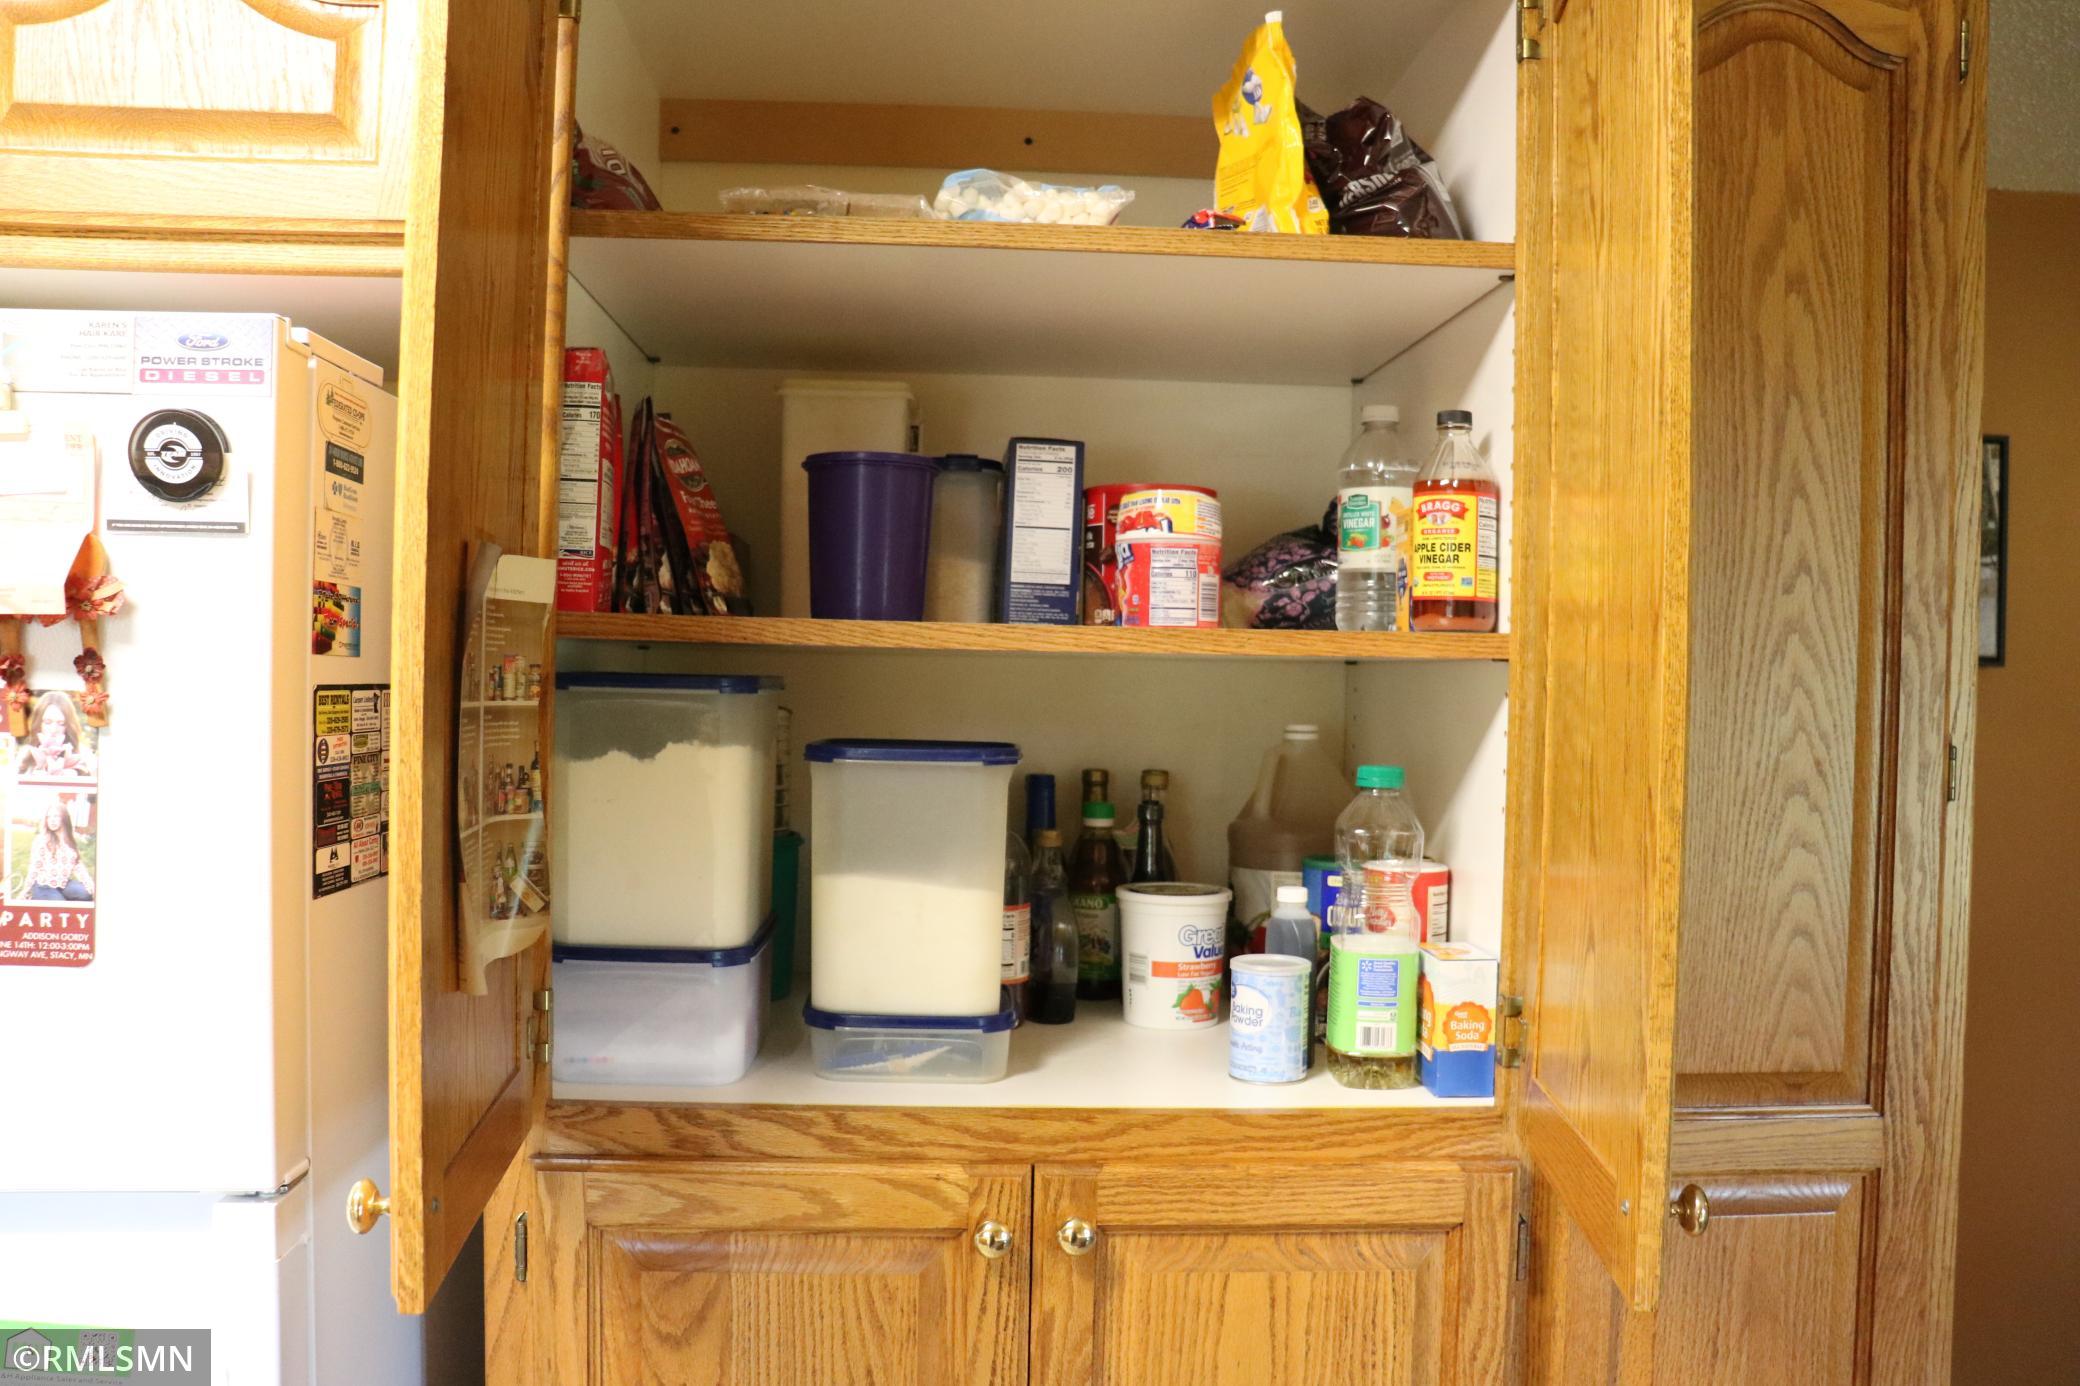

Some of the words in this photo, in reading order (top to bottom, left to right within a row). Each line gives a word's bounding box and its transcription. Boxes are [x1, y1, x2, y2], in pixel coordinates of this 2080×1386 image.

[184, 334, 221, 349] Ford
[140, 356, 197, 365] POWER
[200, 357, 264, 366] STROKE
[144, 369, 261, 383] DIESEL
[589, 411, 601, 419] 170
[1057, 465, 1073, 473] 200
[1421, 500, 1461, 512] BRAGG
[1343, 517, 1375, 529] VINEGAR
[1414, 543, 1436, 553] APPLE
[1440, 543, 1471, 553] CIDER
[1419, 554, 1460, 564] VINEGAR
[0, 911, 89, 929] PARTY
[22, 933, 60, 941] ADDISON
[1178, 924, 1224, 947] Grea
[78, 953, 94, 961] MN
[1194, 945, 1226, 959] Valu
[1450, 1020, 1485, 1032] Baking
[1455, 1030, 1480, 1040] Soda
